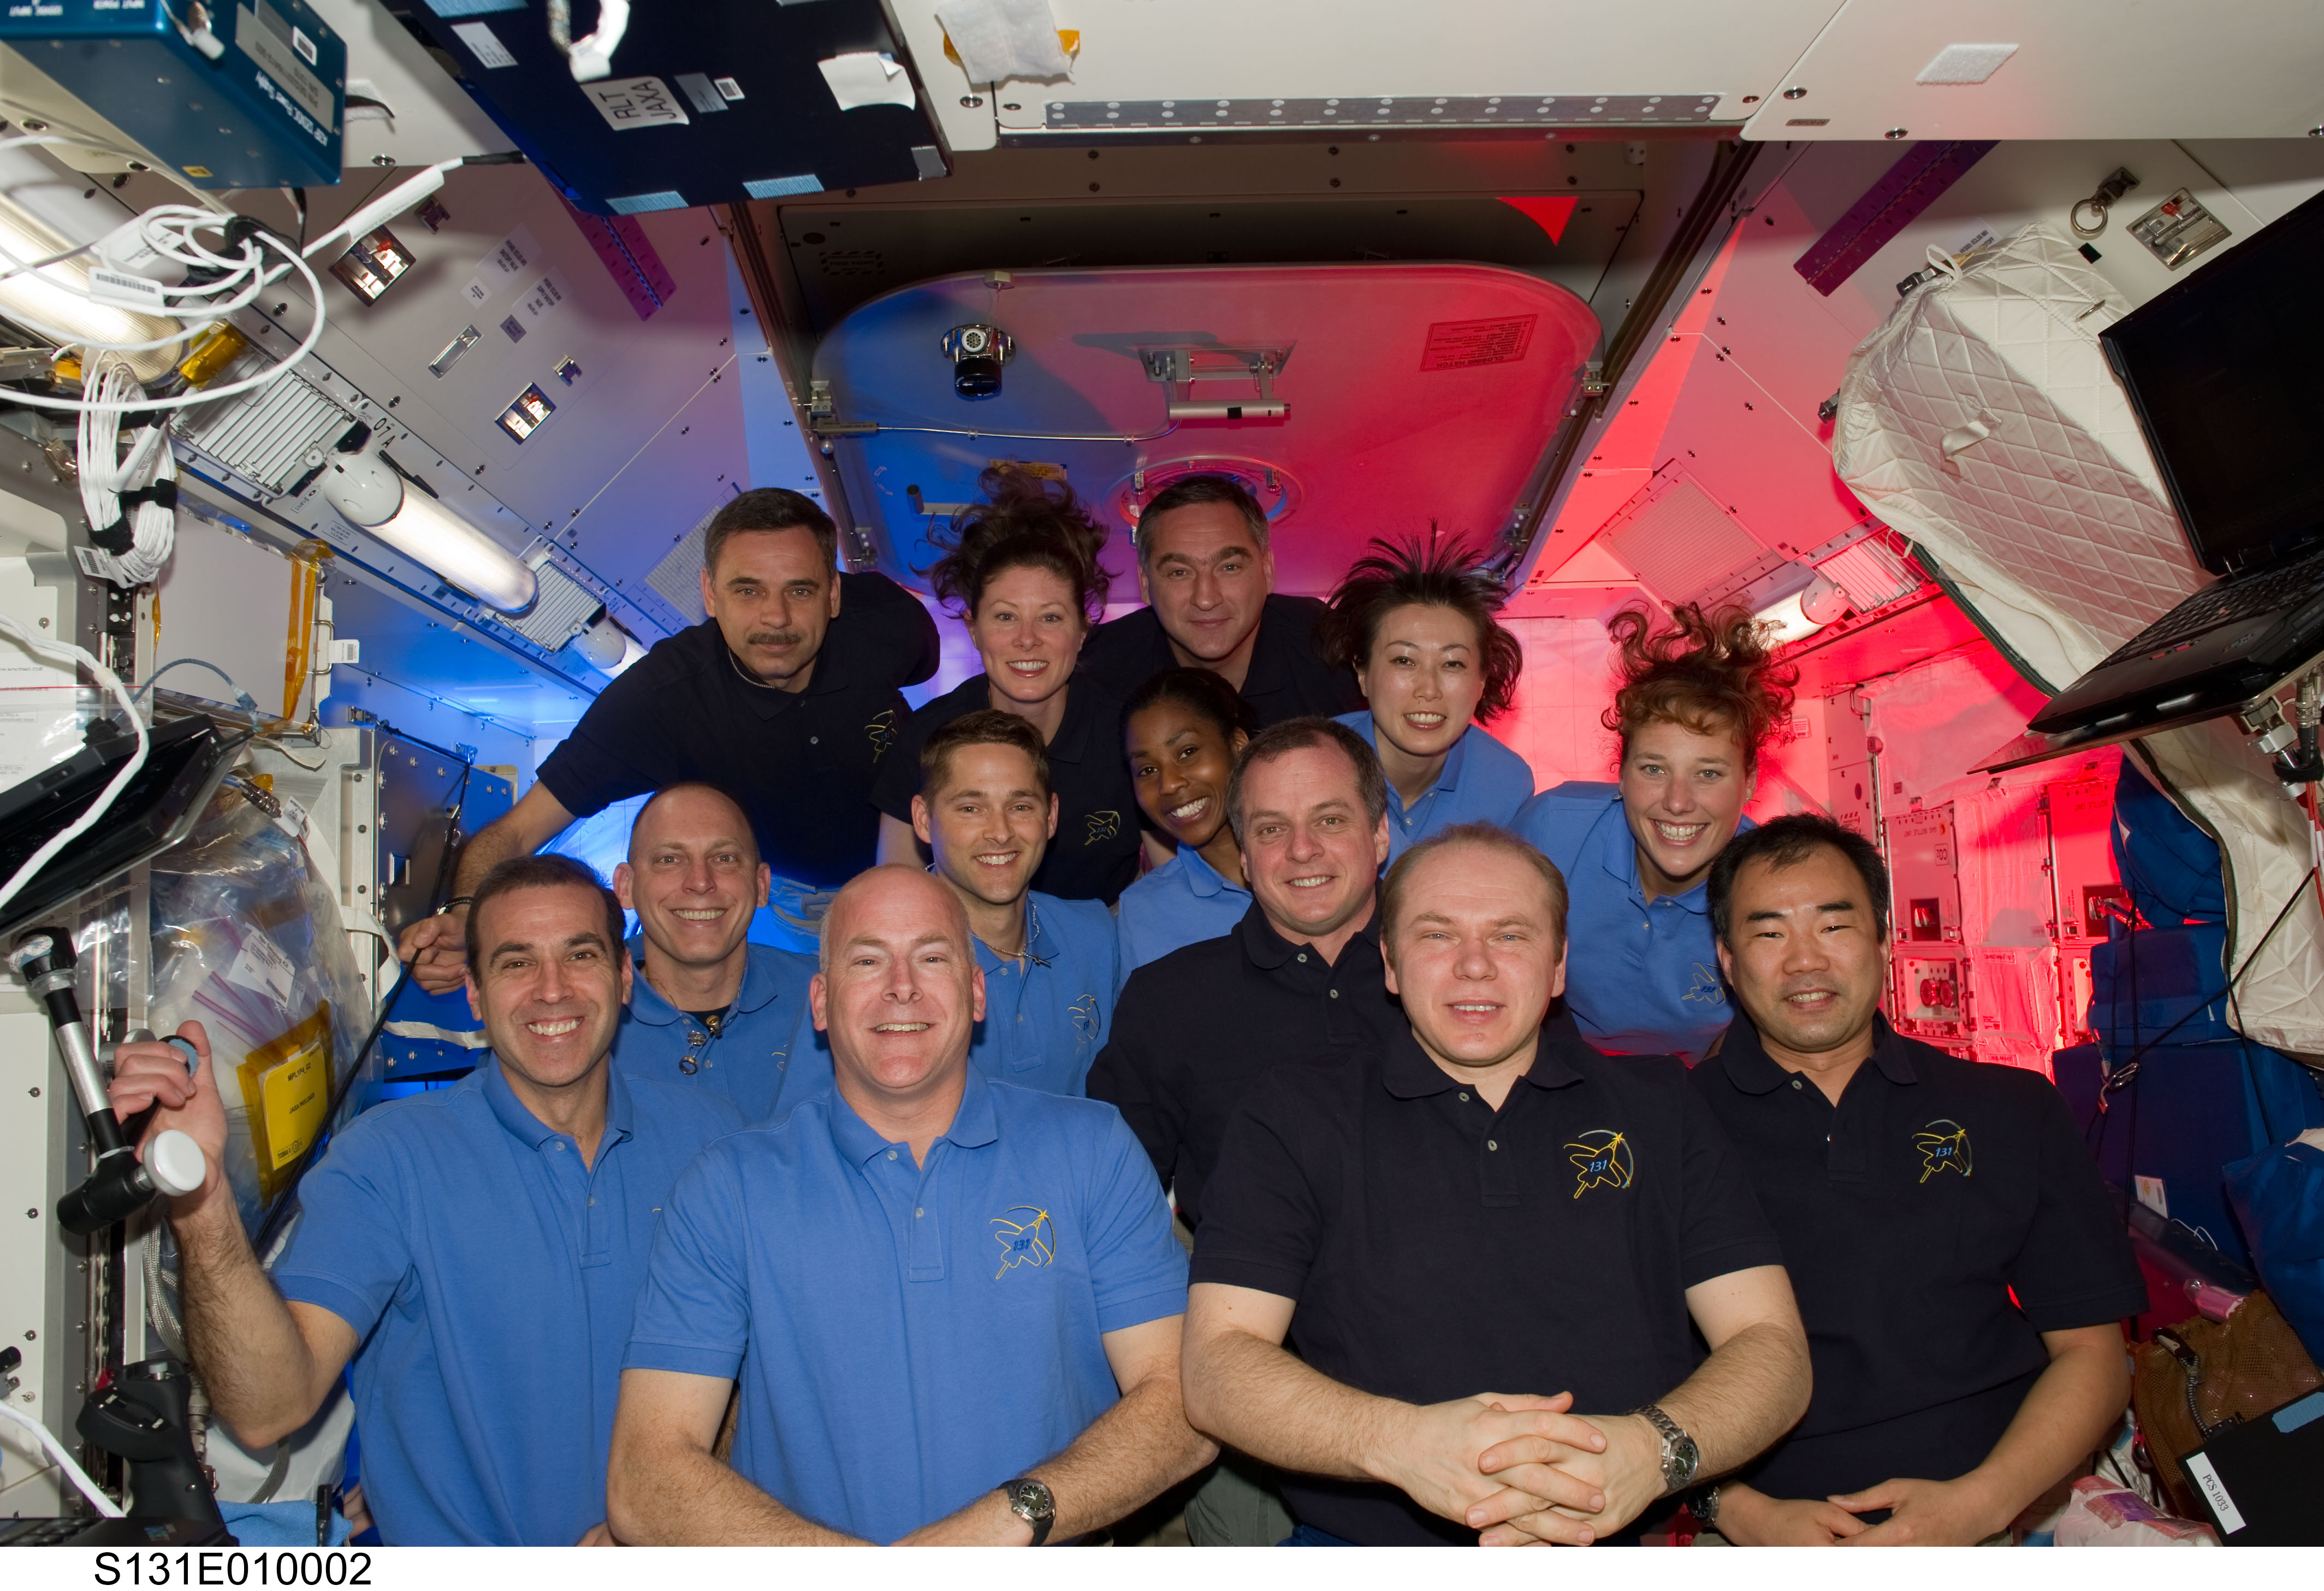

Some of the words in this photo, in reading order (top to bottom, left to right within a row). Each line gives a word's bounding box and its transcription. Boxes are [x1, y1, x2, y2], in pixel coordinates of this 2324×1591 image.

[598, 92, 642, 120] RLT
[631, 80, 678, 119] JAXA
[1437, 360, 1465, 368] HATCH
[1467, 355, 1504, 364] CLOSING
[1935, 1146, 1953, 1157] 131
[1588, 1159, 1609, 1173] 131
[1012, 1238, 1031, 1252] 131
[2202, 1474, 2217, 1491] PCS
[2212, 1491, 2229, 1511] 1033
